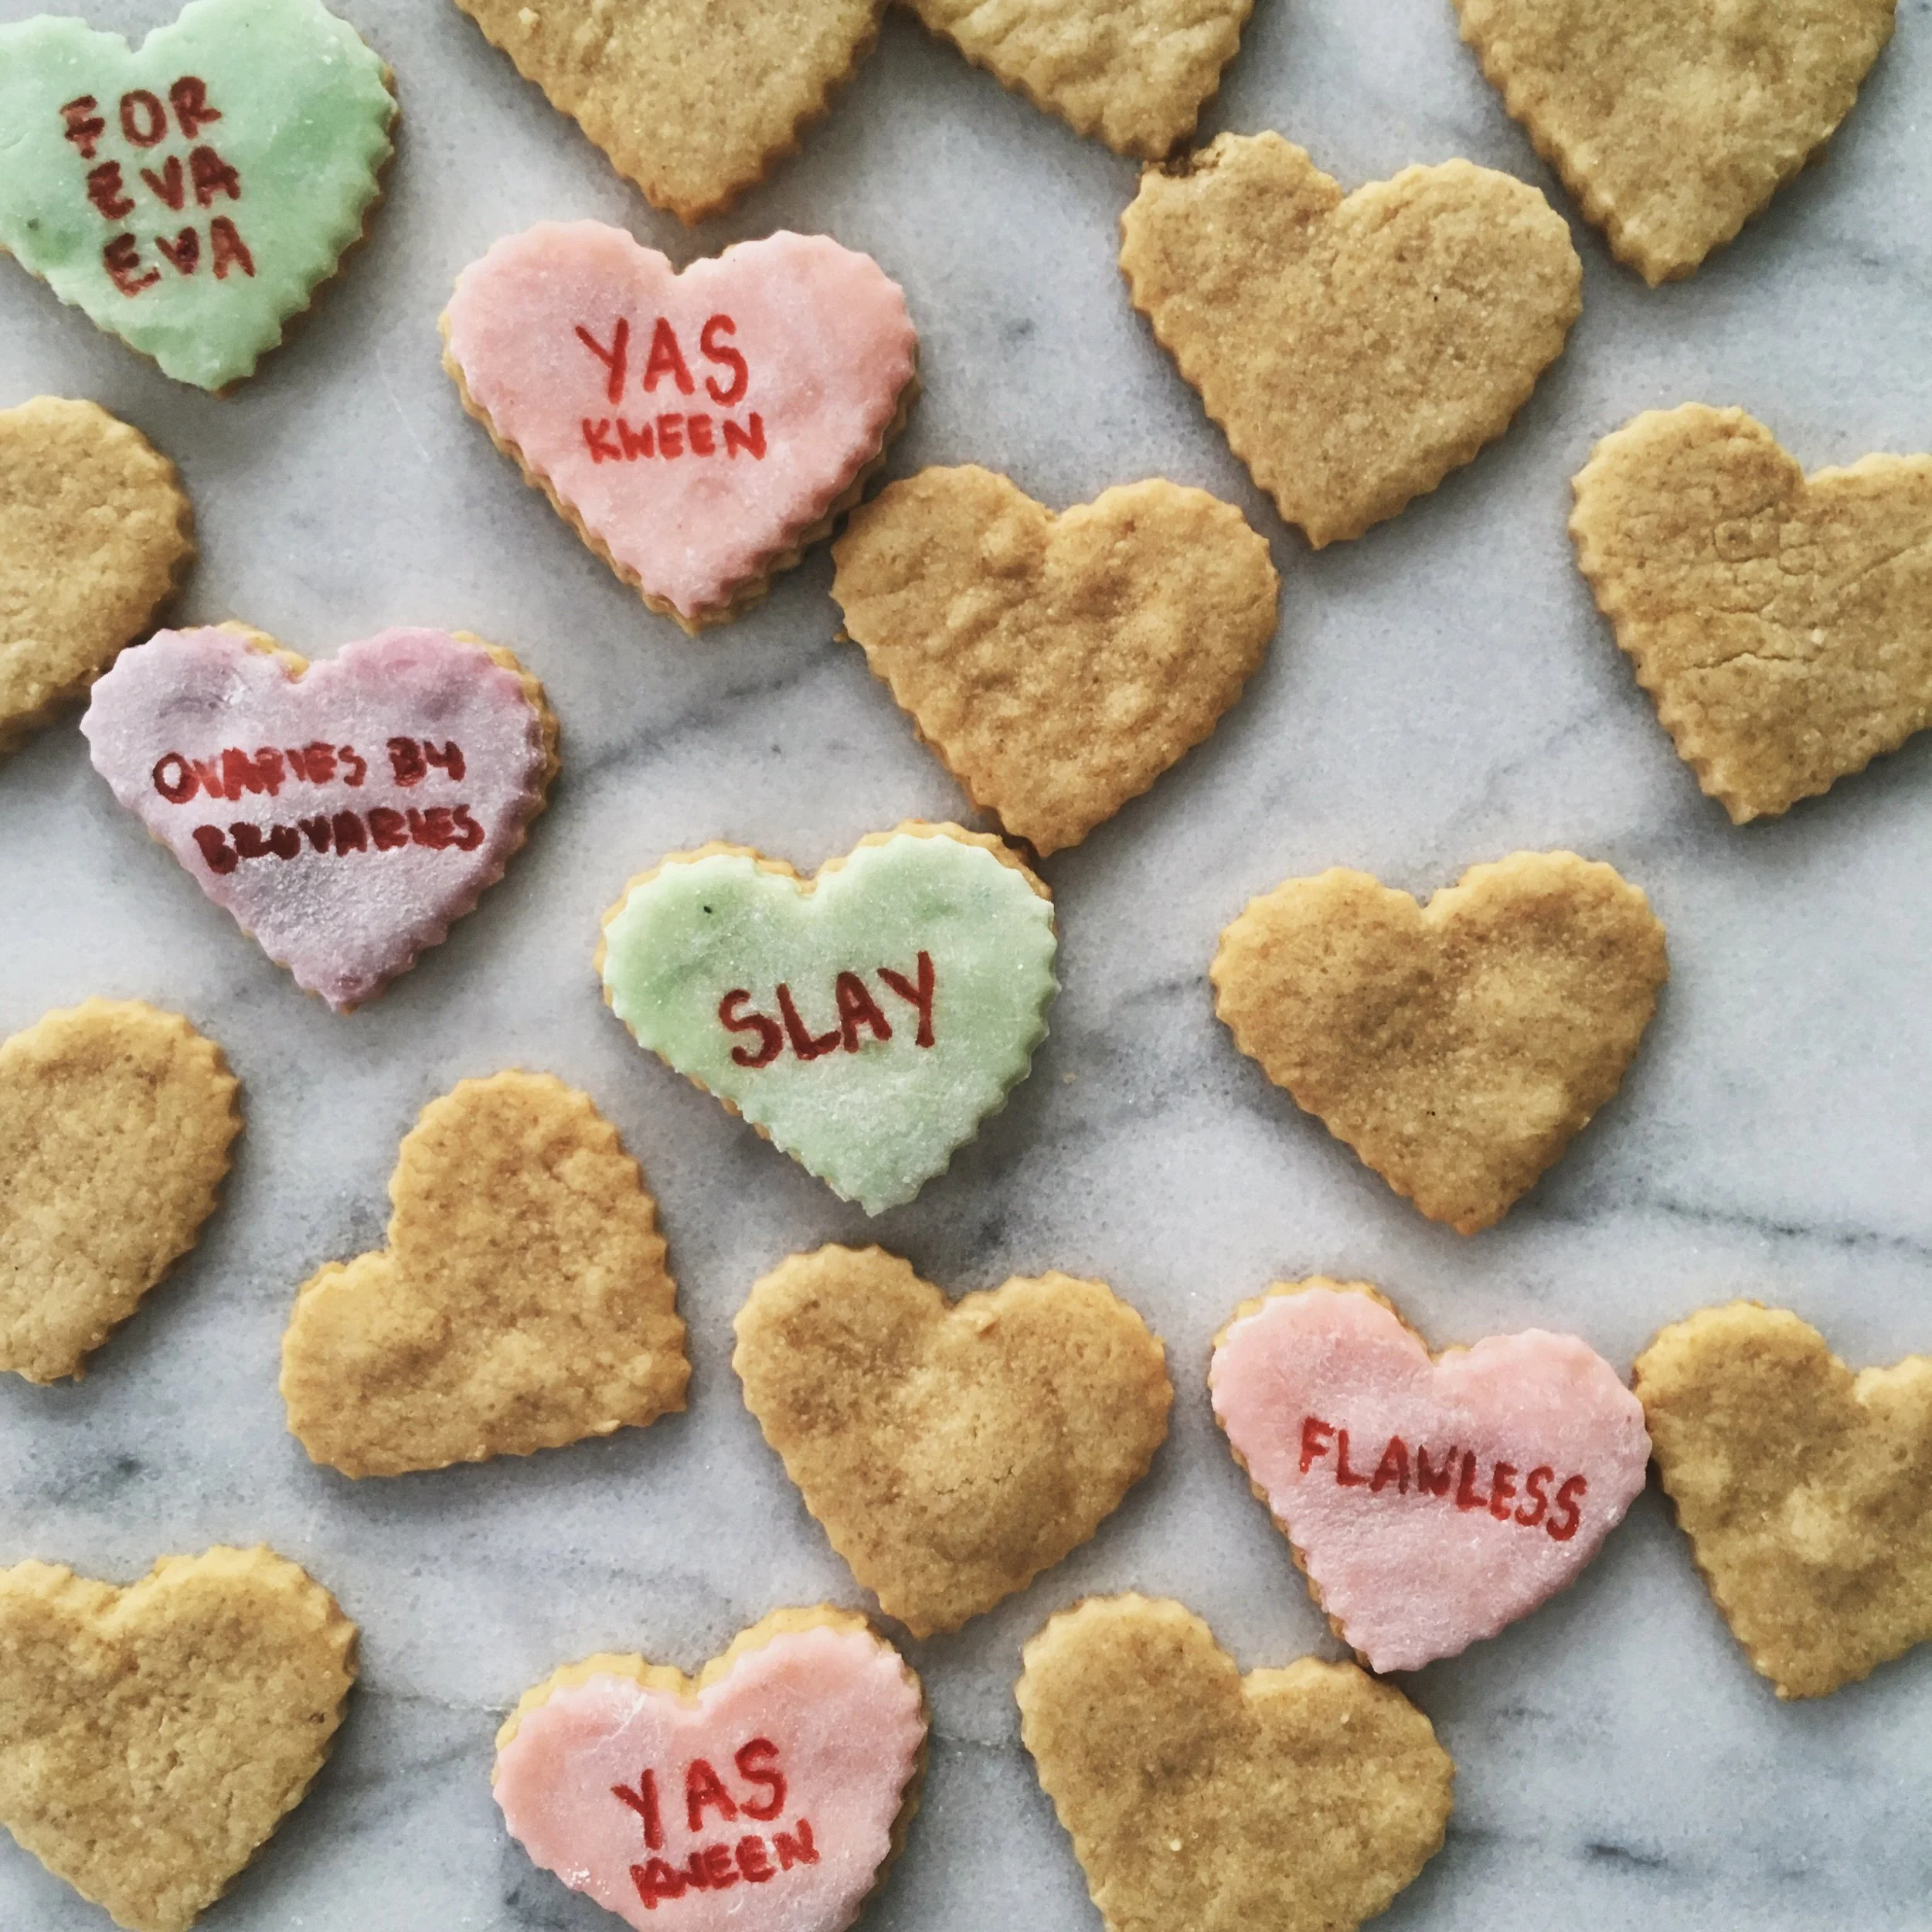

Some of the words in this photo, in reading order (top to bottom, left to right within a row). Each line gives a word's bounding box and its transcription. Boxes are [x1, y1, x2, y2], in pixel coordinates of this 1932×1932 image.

[60, 75, 223, 158] FOR
[87, 145, 241, 220] EVA
[102, 216, 256, 298] EVA
[575, 315, 749, 406] YAS
[581, 411, 767, 464] KWEEN
[153, 742, 367, 804] OVARIES
[718, 951, 936, 1069] SLAY
[1299, 1416, 1587, 1542] FLAWLESS
[611, 1737, 787, 1851] YAS
[629, 1818, 820, 1910] KWEEN
